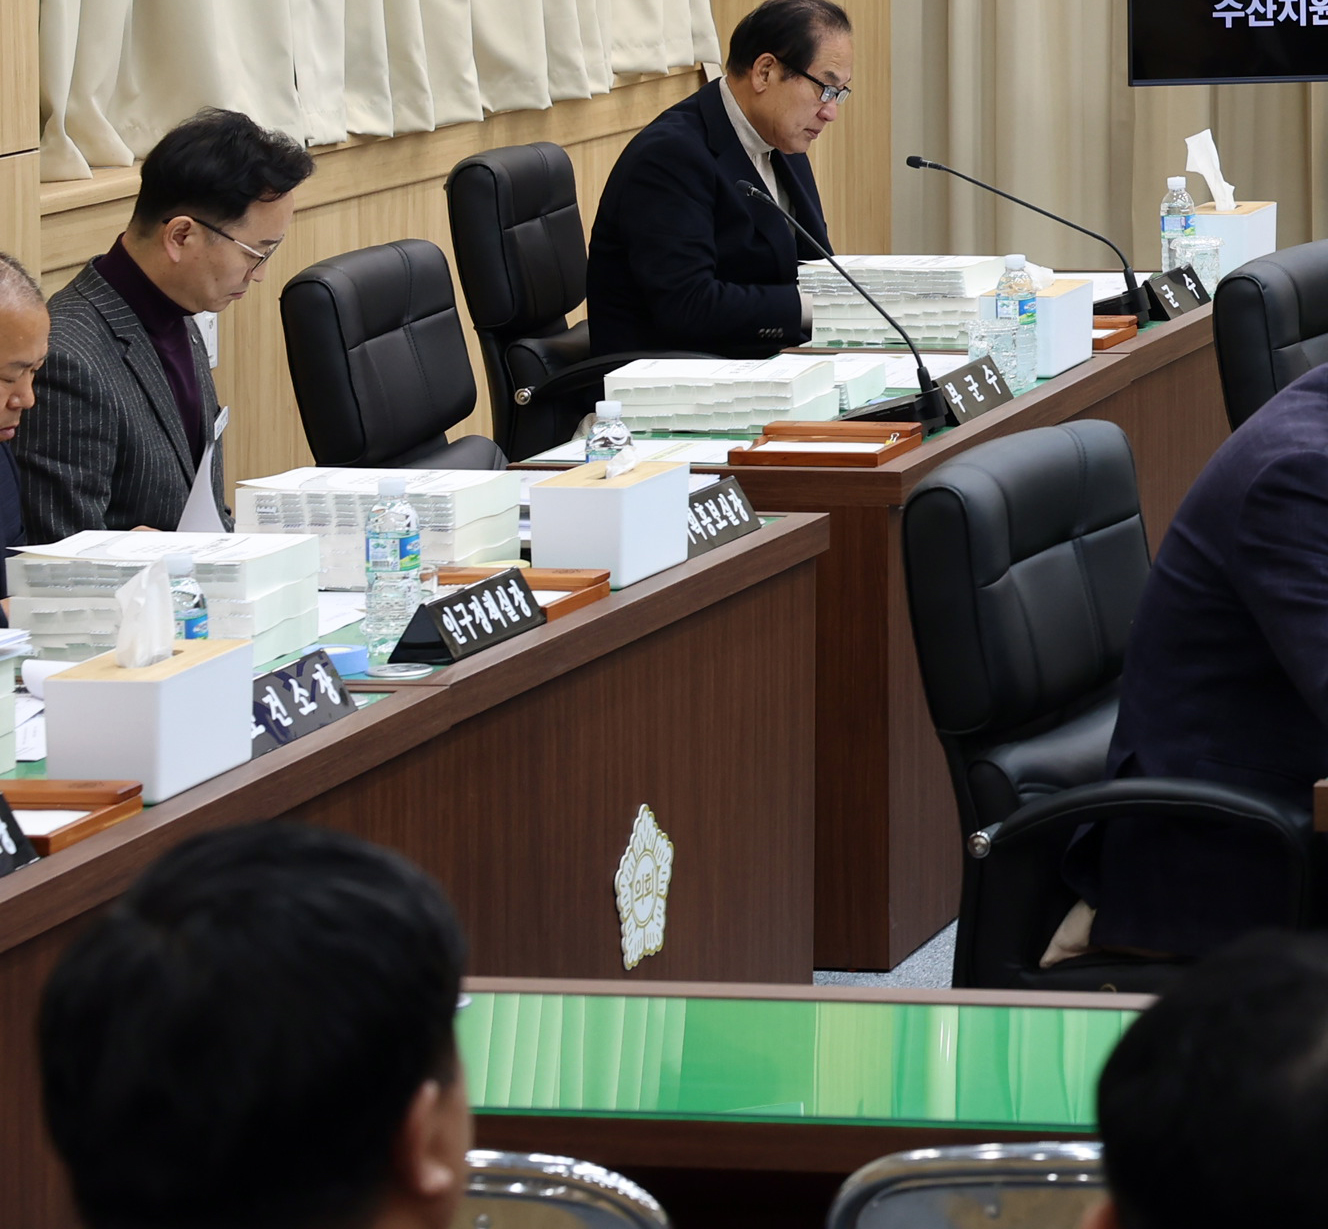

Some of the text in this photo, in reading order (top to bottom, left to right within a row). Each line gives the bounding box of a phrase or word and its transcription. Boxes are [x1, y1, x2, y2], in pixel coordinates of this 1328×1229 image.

[944, 364, 1002, 413] 부군수
[688, 487, 750, 545] 획홍보실장
[441, 578, 532, 646] 인구정책실장
